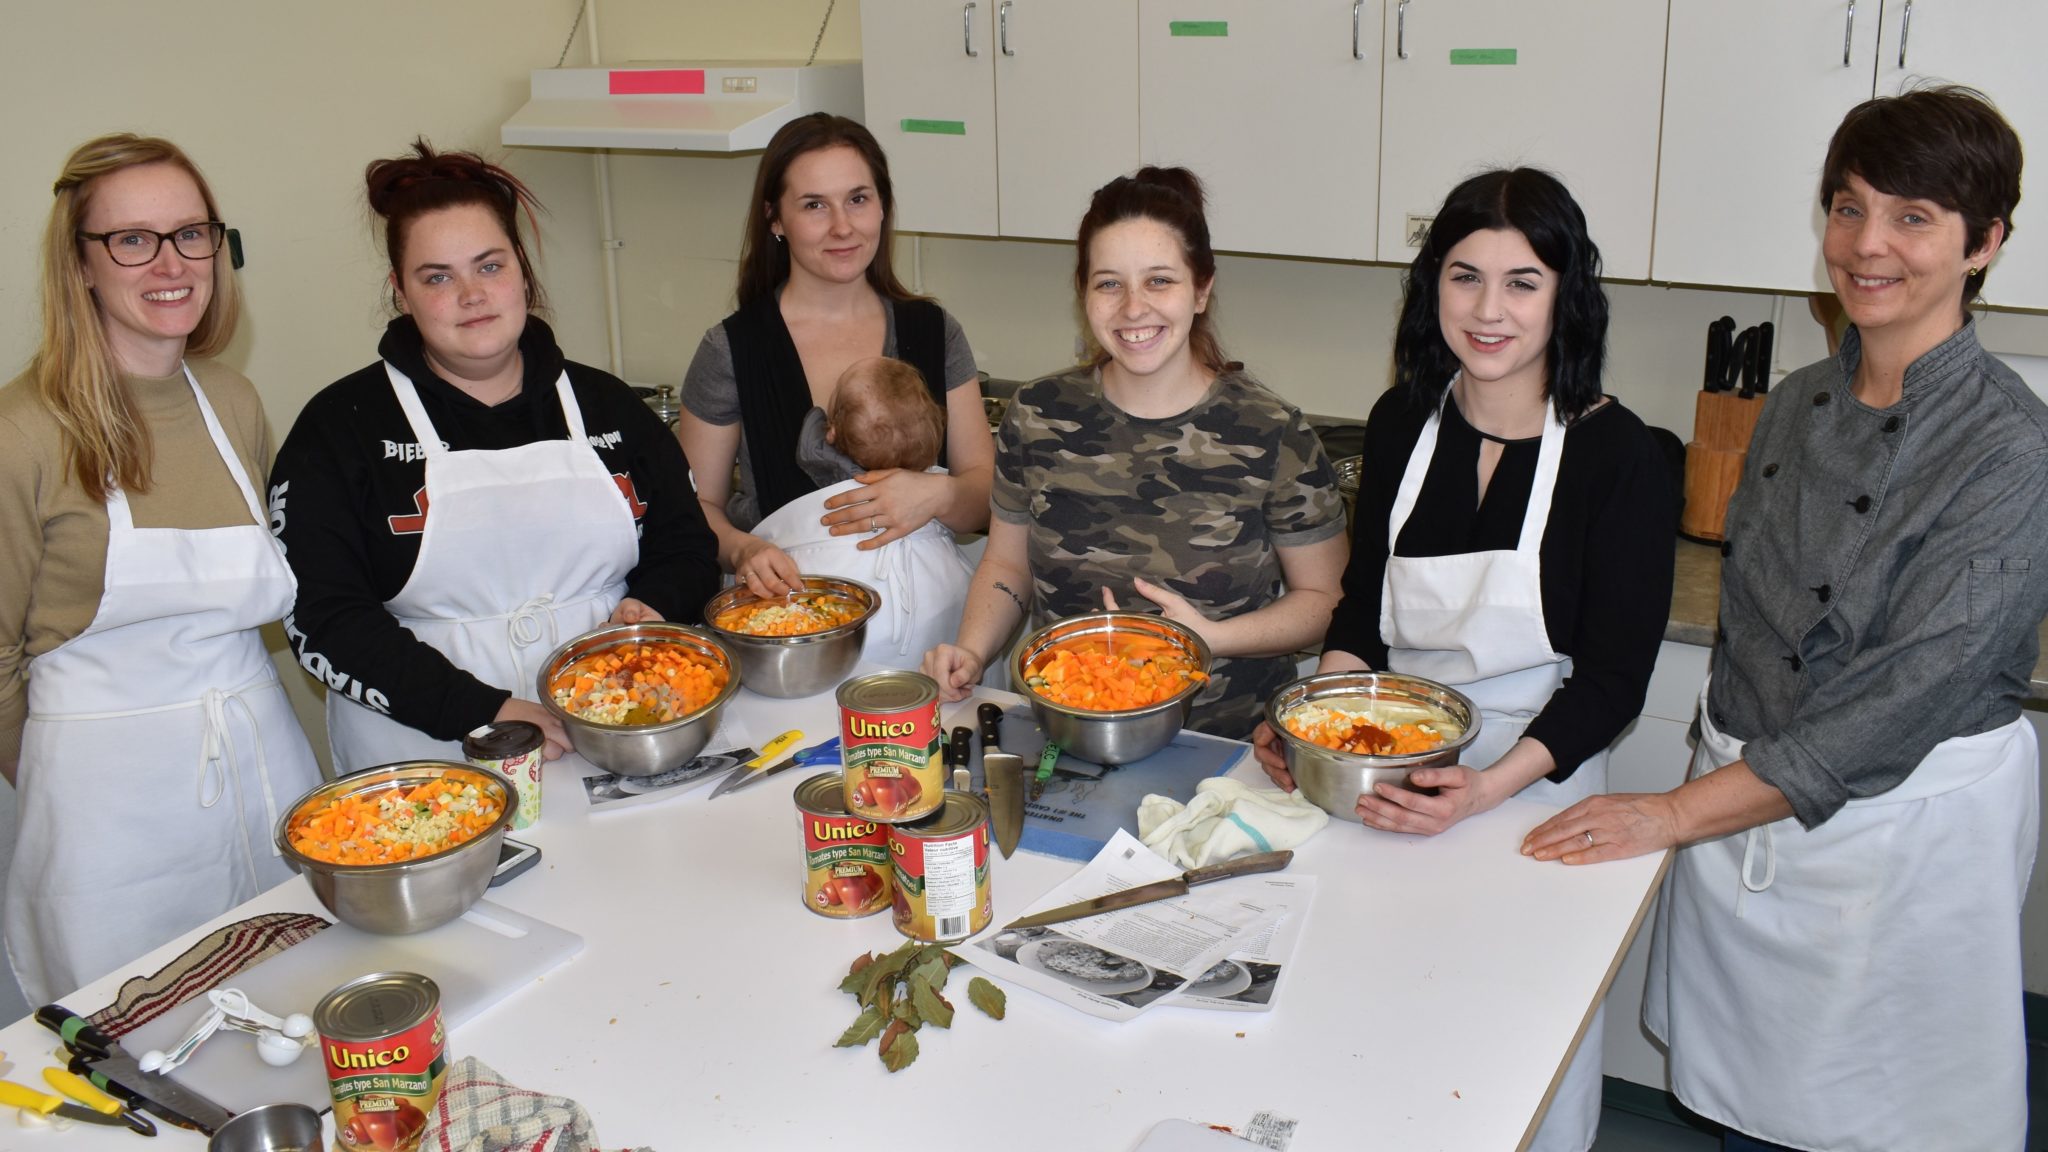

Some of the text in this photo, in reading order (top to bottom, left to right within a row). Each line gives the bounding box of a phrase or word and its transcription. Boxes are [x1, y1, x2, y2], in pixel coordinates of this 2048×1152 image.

[380, 440, 451, 463] BIEB
[850, 716, 916, 738] Unico
[867, 747, 882, 760] type
[883, 746, 897, 757] San
[899, 748, 926, 764] Marzano
[869, 766, 900, 775] PREMIUM
[814, 821, 878, 841] Unico
[832, 848, 847, 860] type
[848, 847, 861, 857] San
[863, 849, 887, 861] Marzano
[835, 865, 864, 875] PREMIUM
[329, 1044, 410, 1070] Unico
[353, 1080, 372, 1092] type
[373, 1078, 390, 1088] San
[392, 1078, 428, 1090] Marzano
[359, 1098, 395, 1109] PREMIUM
